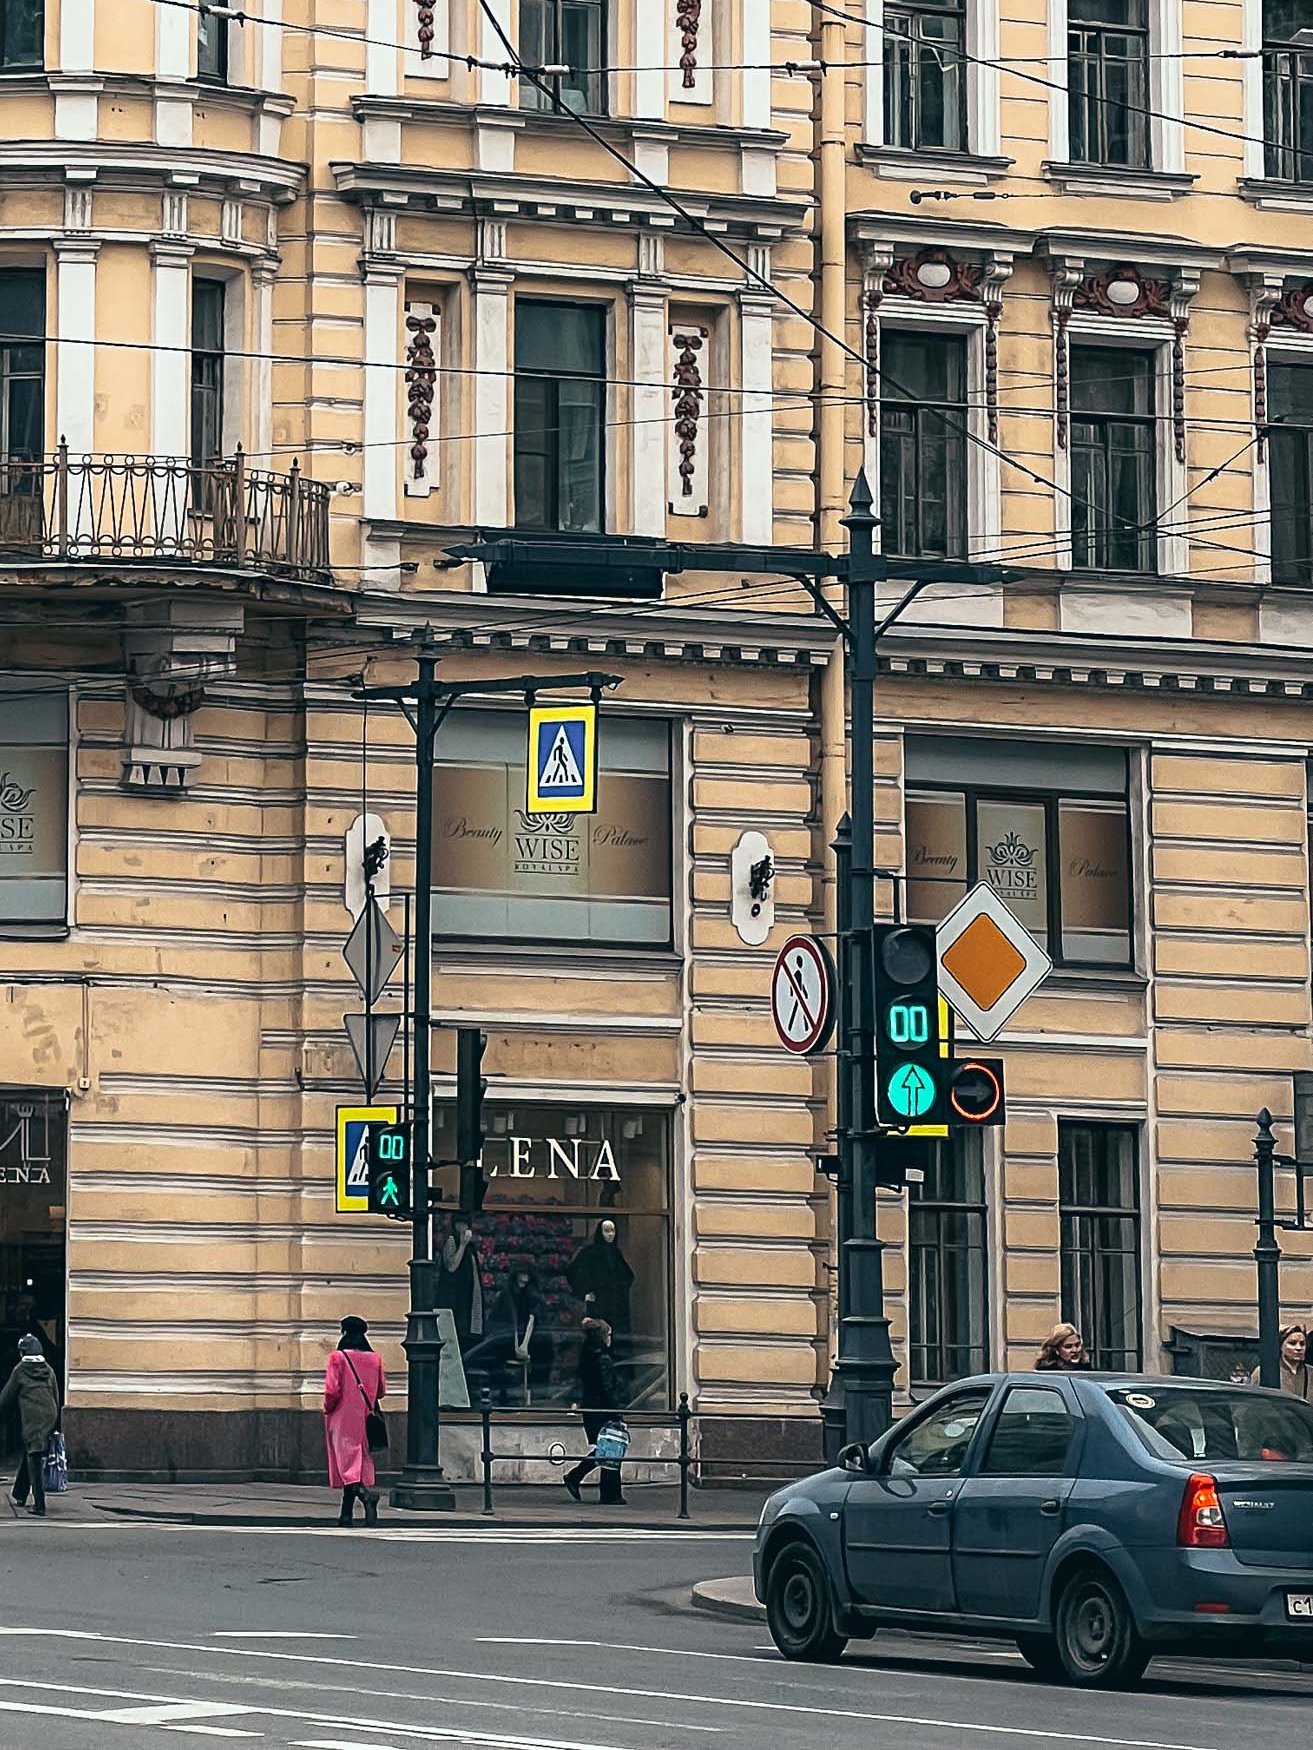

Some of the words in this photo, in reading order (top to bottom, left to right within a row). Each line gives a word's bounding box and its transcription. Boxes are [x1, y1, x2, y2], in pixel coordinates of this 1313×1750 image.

[443, 817, 503, 848] Beauty
[515, 837, 580, 861] WISE
[987, 868, 1038, 889] WISE
[890, 1005, 929, 1043] 00
[379, 1134, 404, 1160] 00
